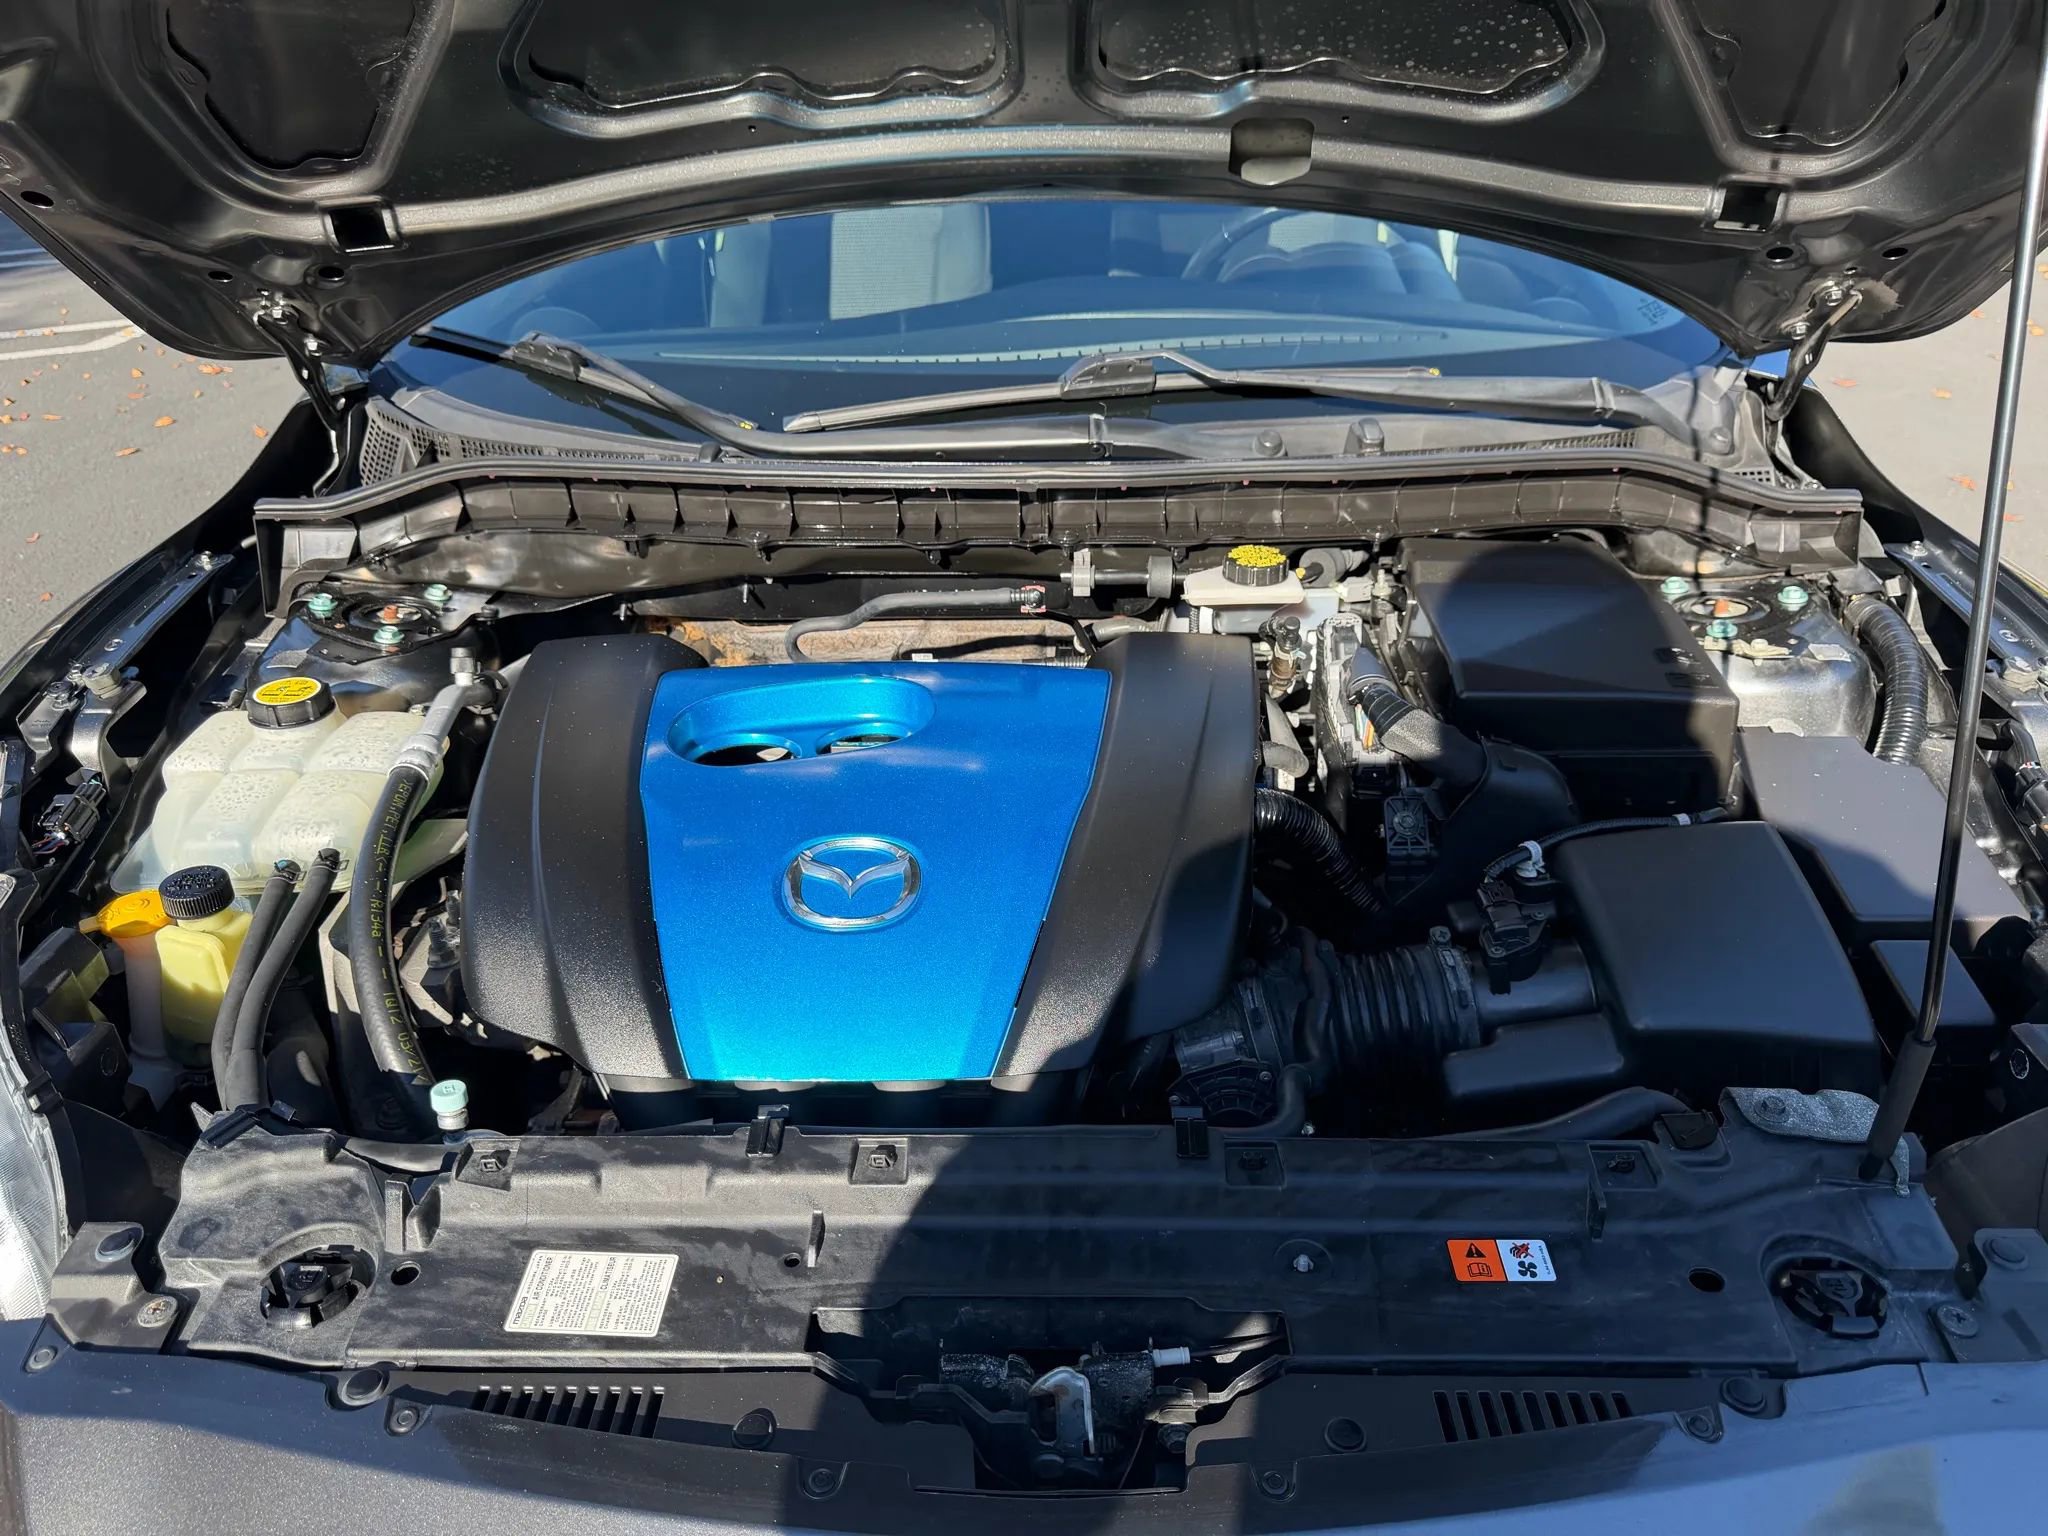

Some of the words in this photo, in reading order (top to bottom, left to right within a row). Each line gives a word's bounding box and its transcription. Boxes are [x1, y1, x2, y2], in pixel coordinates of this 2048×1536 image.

[369, 899, 384, 937] R134a
[534, 1256, 554, 1290] CONDITIONER
[599, 1256, 617, 1289] CLIMATISEUR
[512, 1296, 528, 1324] mazda
[531, 1291, 541, 1299] AIR
